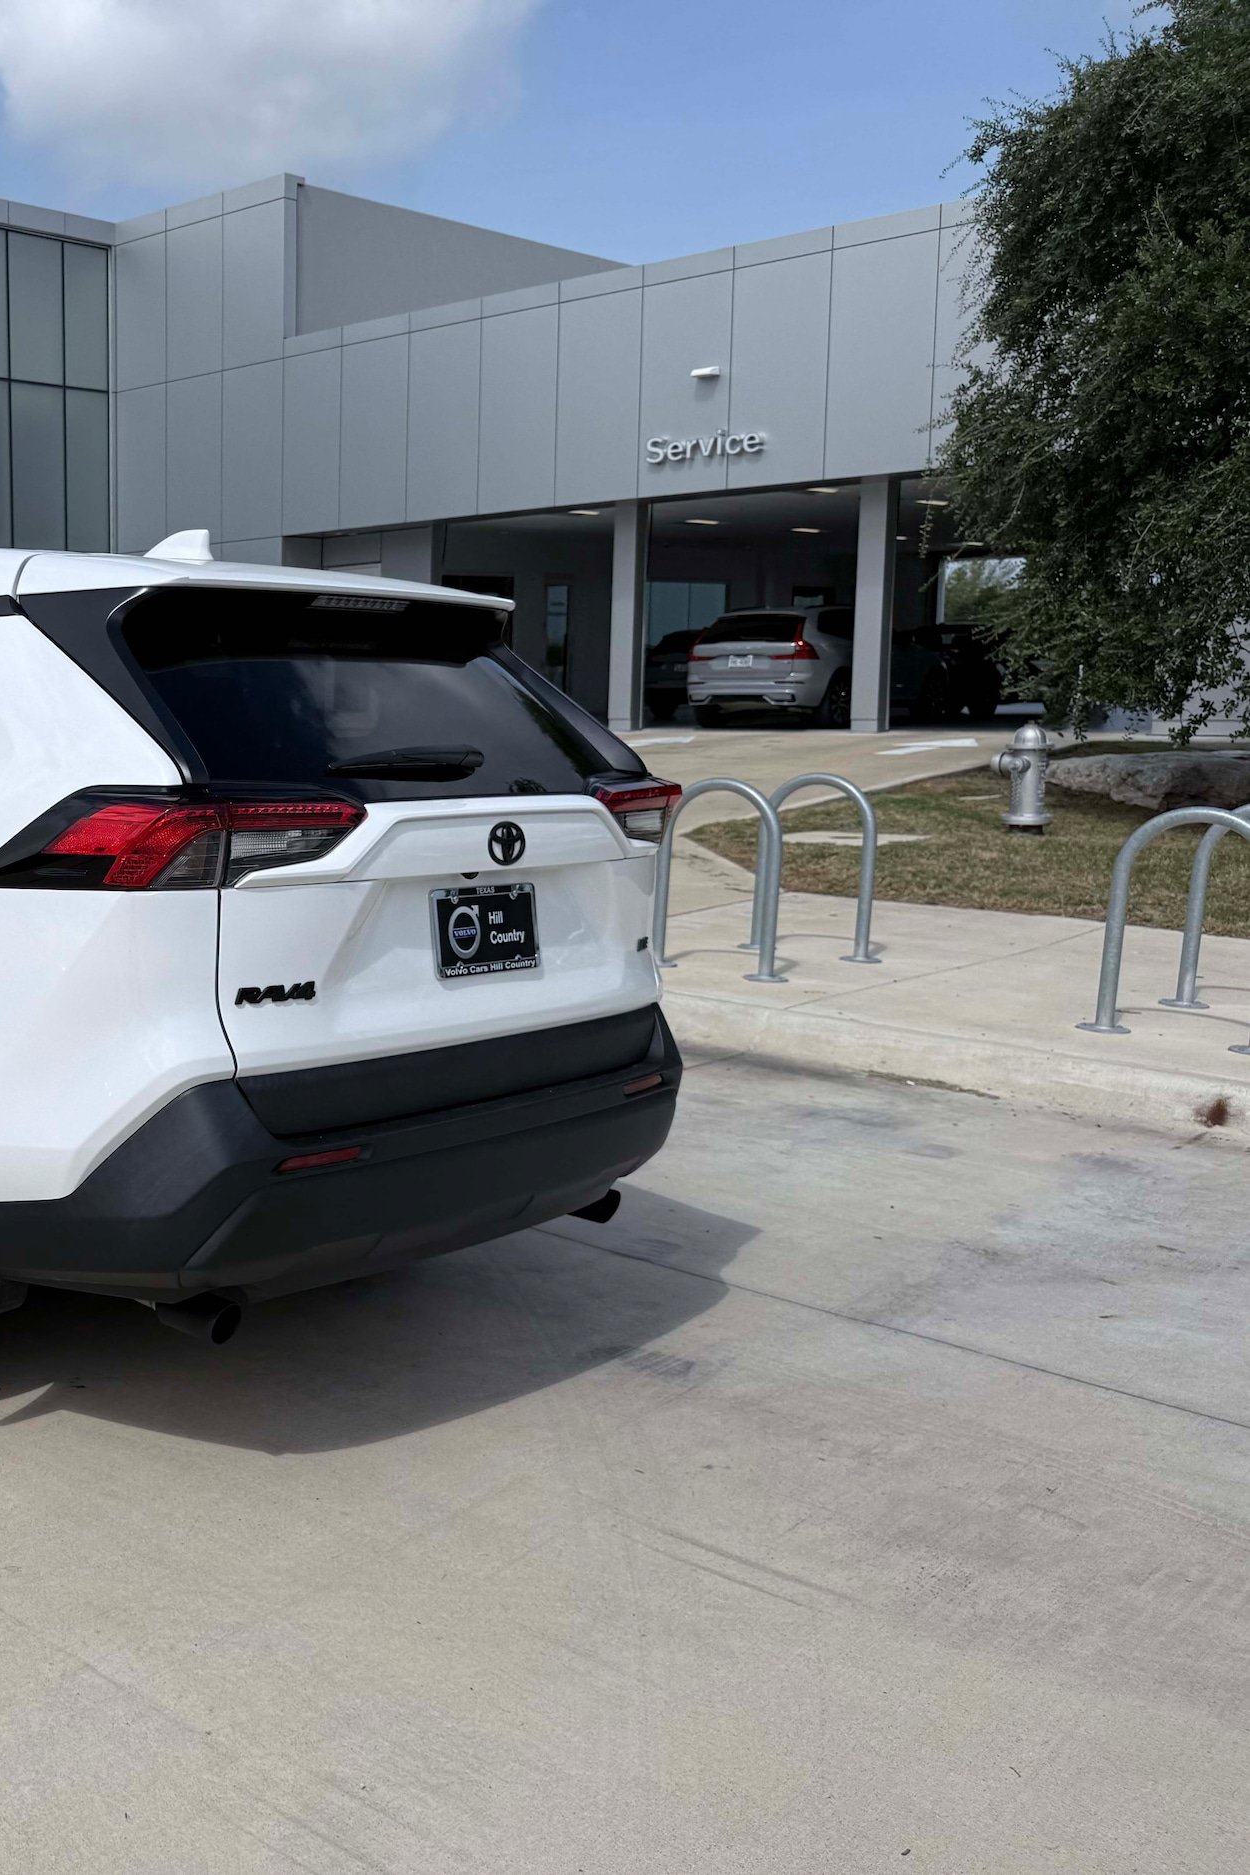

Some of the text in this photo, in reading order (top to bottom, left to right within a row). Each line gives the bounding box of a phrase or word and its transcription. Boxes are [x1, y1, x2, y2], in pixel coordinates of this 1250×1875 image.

[646, 429, 761, 463] Service
[476, 887, 495, 895] TEXAS
[488, 910, 503, 925] Hill
[490, 928, 525, 944] Country
[445, 959, 535, 977] Volvo Cars Hill Country
[234, 981, 316, 1005] RAV4
